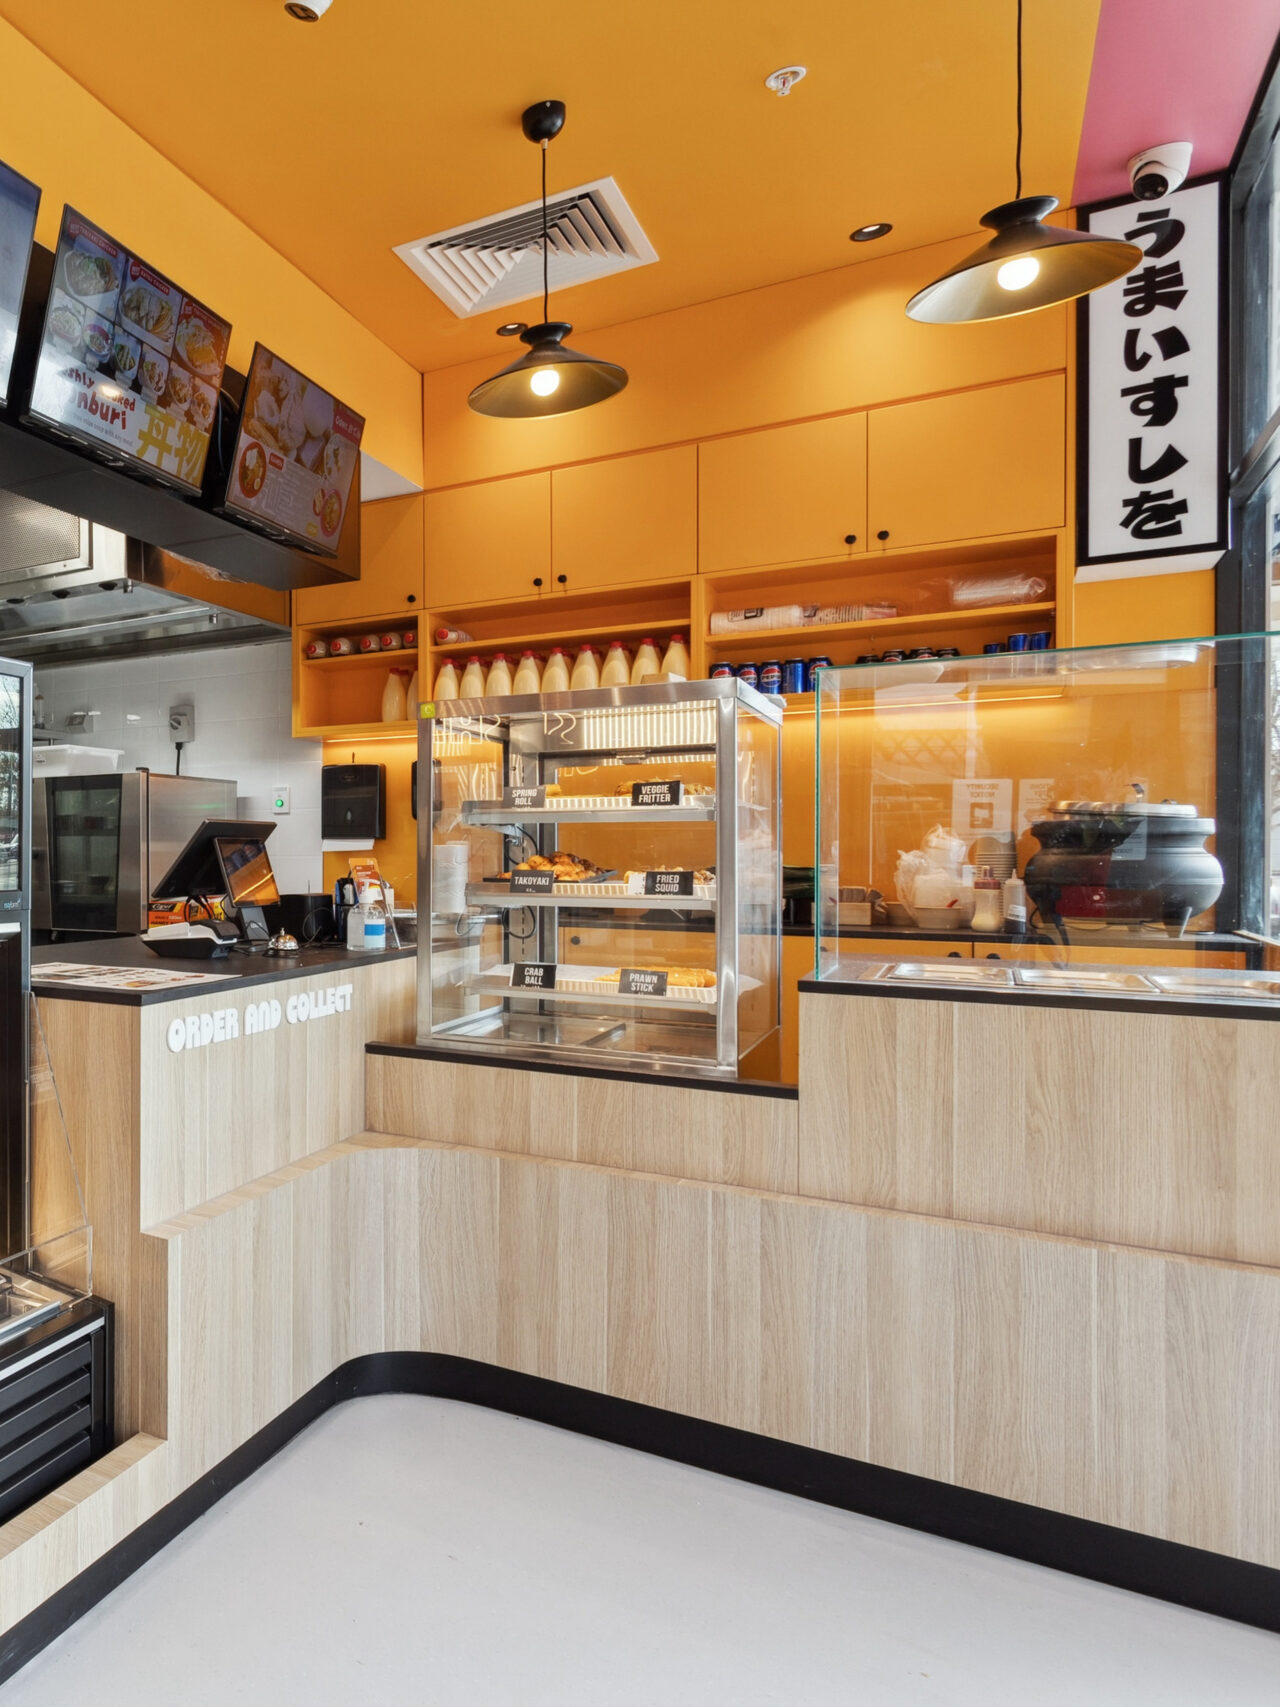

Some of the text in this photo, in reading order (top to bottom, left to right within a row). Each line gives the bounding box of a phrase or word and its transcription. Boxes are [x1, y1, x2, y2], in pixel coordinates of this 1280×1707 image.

[1119, 206, 1191, 540] うまいすしを
[76, 390, 127, 431] nburi
[511, 788, 538, 797] SPRING
[641, 785, 670, 795] VEGGIE
[514, 797, 533, 806] ROLL
[638, 793, 671, 804] FRITTER
[514, 876, 550, 886] TAKOYAKI
[656, 874, 680, 884] FRIED
[654, 883, 680, 893] SQUID
[524, 967, 544, 977] CRAB
[524, 976, 543, 985] BALL
[629, 973, 658, 983] PRAWN
[630, 983, 654, 993] STICK
[167, 983, 354, 1053] ORDER AND COLLECT
